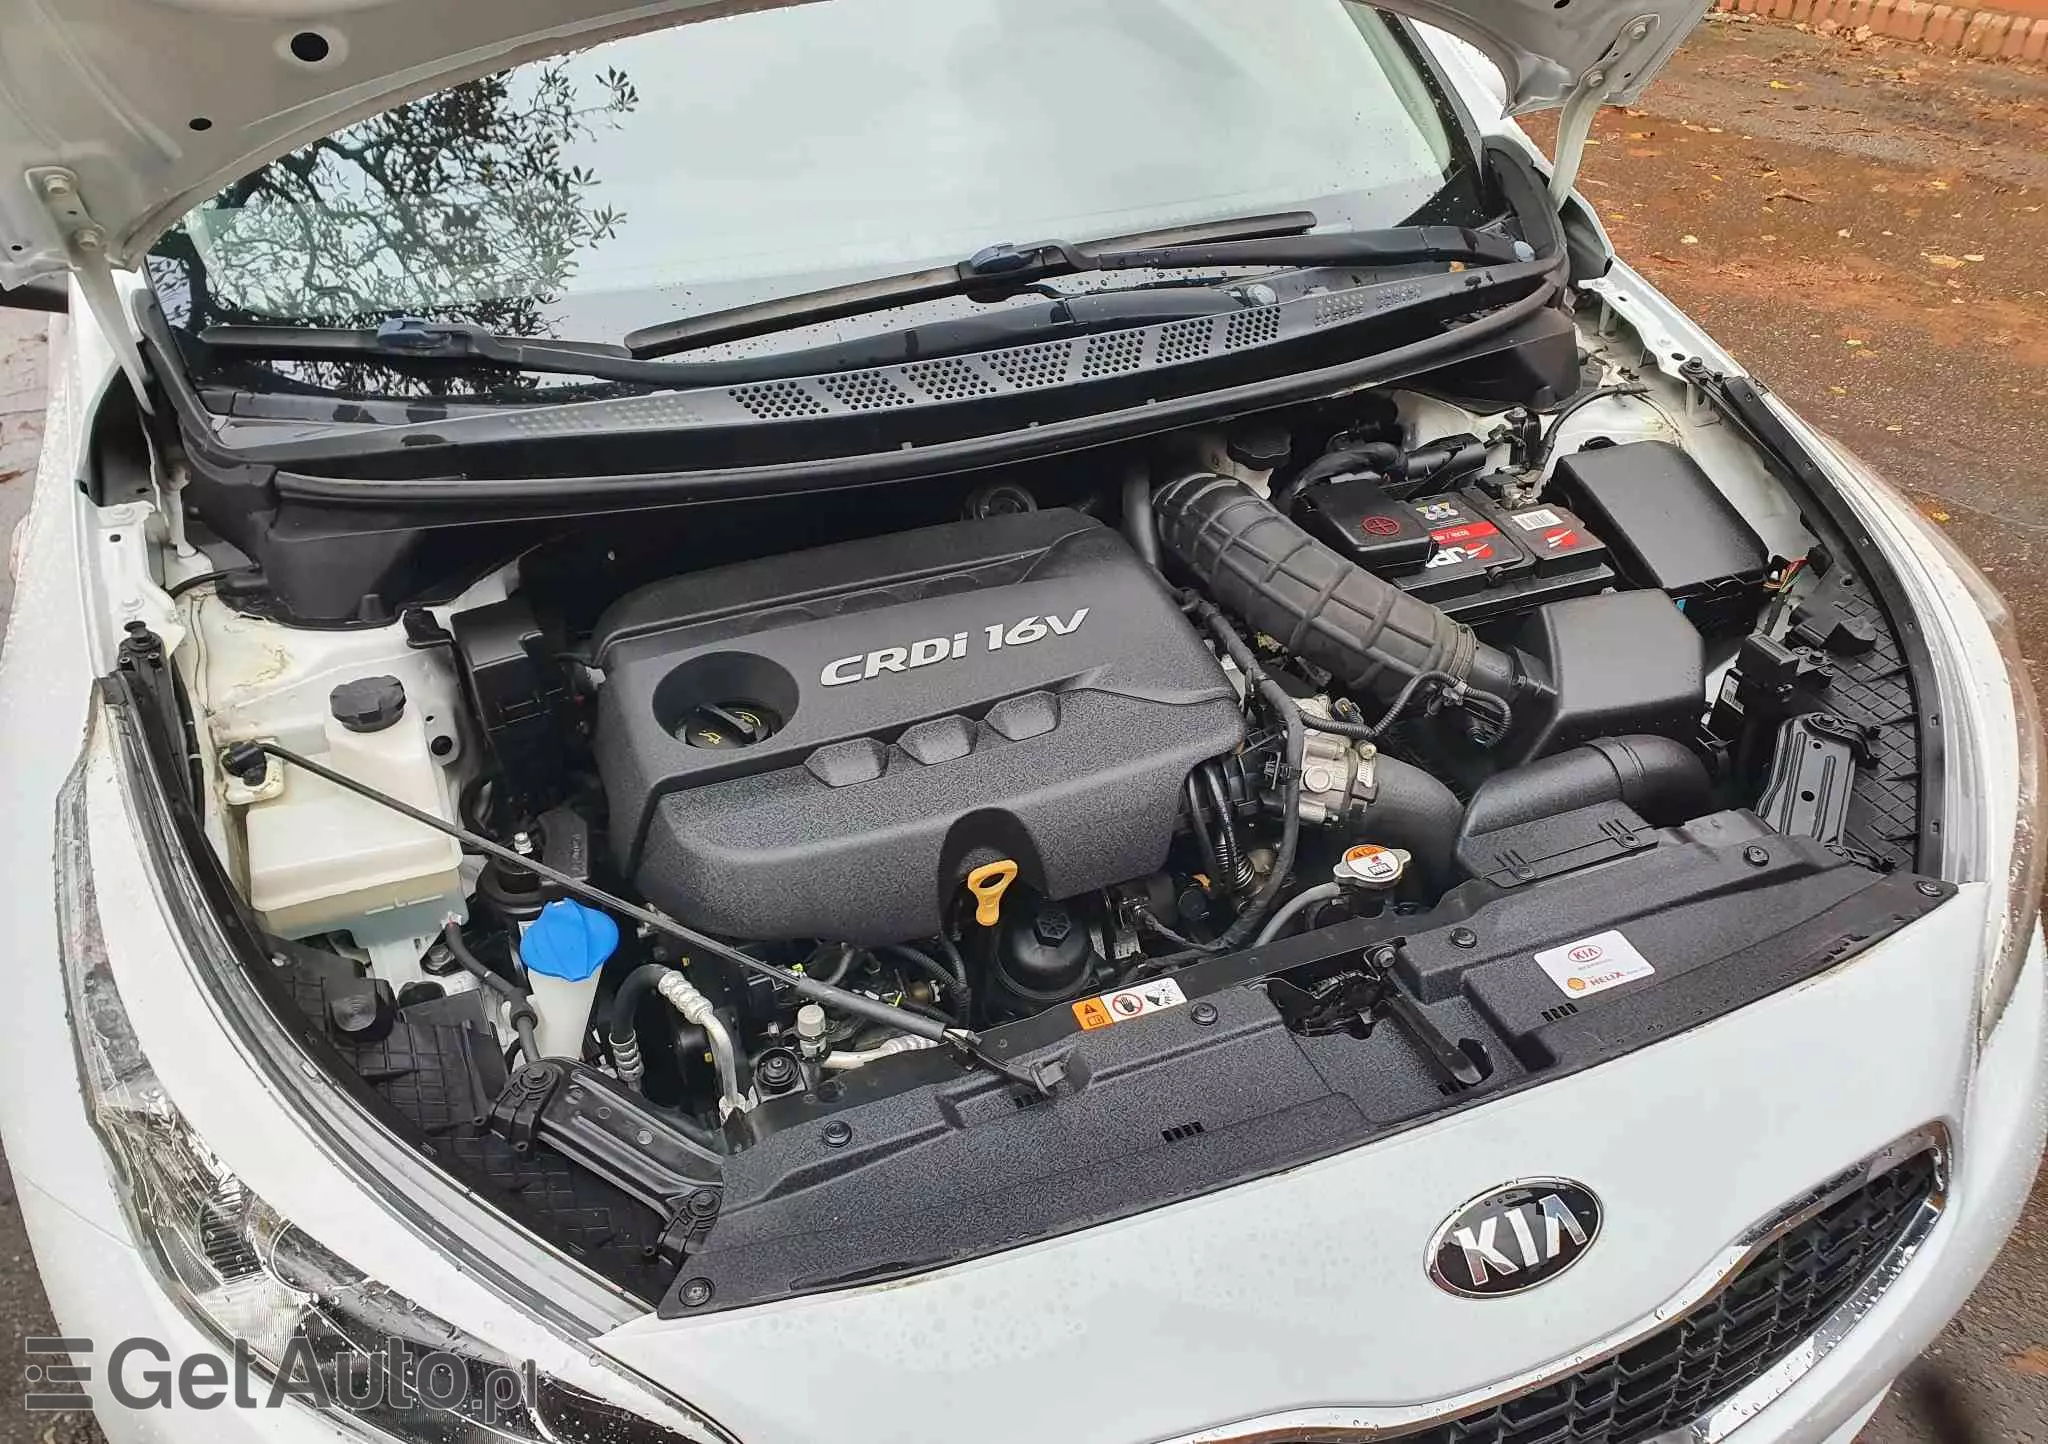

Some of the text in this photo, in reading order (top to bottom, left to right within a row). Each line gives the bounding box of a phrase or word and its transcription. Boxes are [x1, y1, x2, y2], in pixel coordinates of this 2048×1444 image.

[820, 607, 1090, 686] CRDi 16V
[1572, 947, 1599, 961] KIA
[1453, 1193, 1588, 1286] KIA
